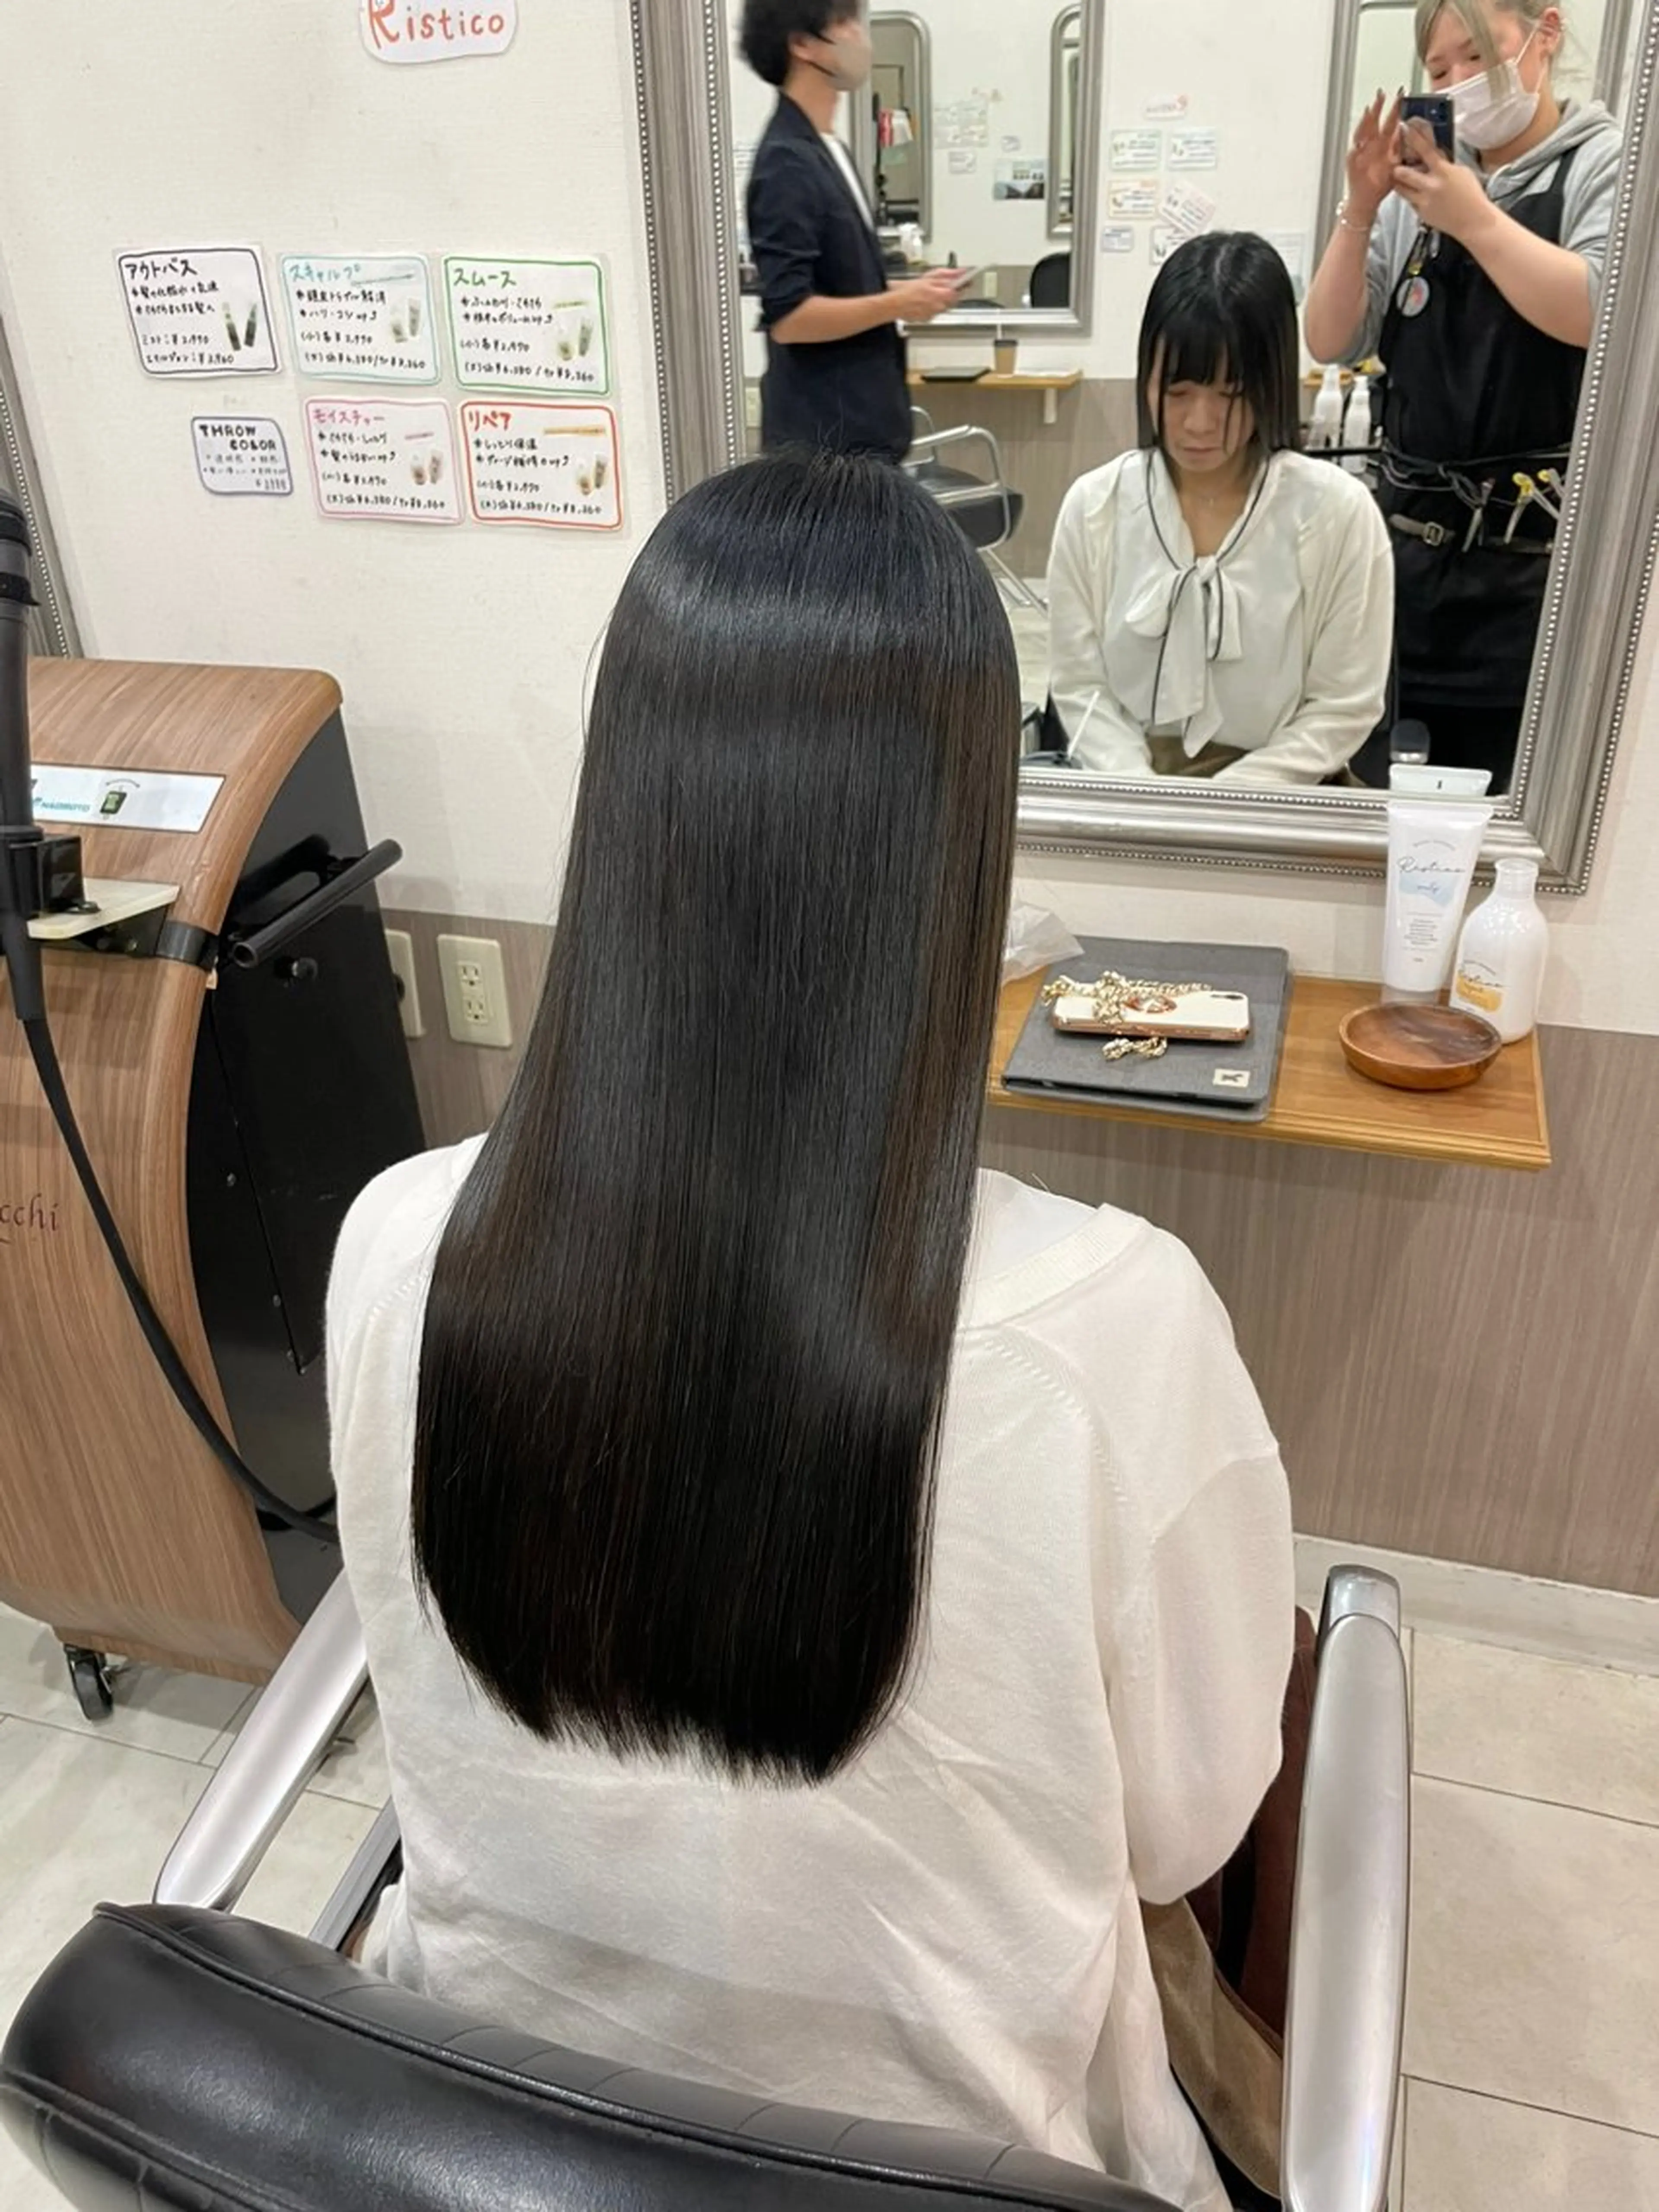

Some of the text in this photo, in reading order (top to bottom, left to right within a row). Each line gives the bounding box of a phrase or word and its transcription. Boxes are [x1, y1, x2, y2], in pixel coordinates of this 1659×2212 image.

[368, 0, 504, 49] Ristico
[125, 257, 198, 280] アウトバス
[454, 268, 517, 289] スムース
[313, 409, 385, 427] モイスチャー
[468, 410, 511, 432] リペア
[199, 424, 256, 437] THROW
[230, 439, 276, 451] COLOR
